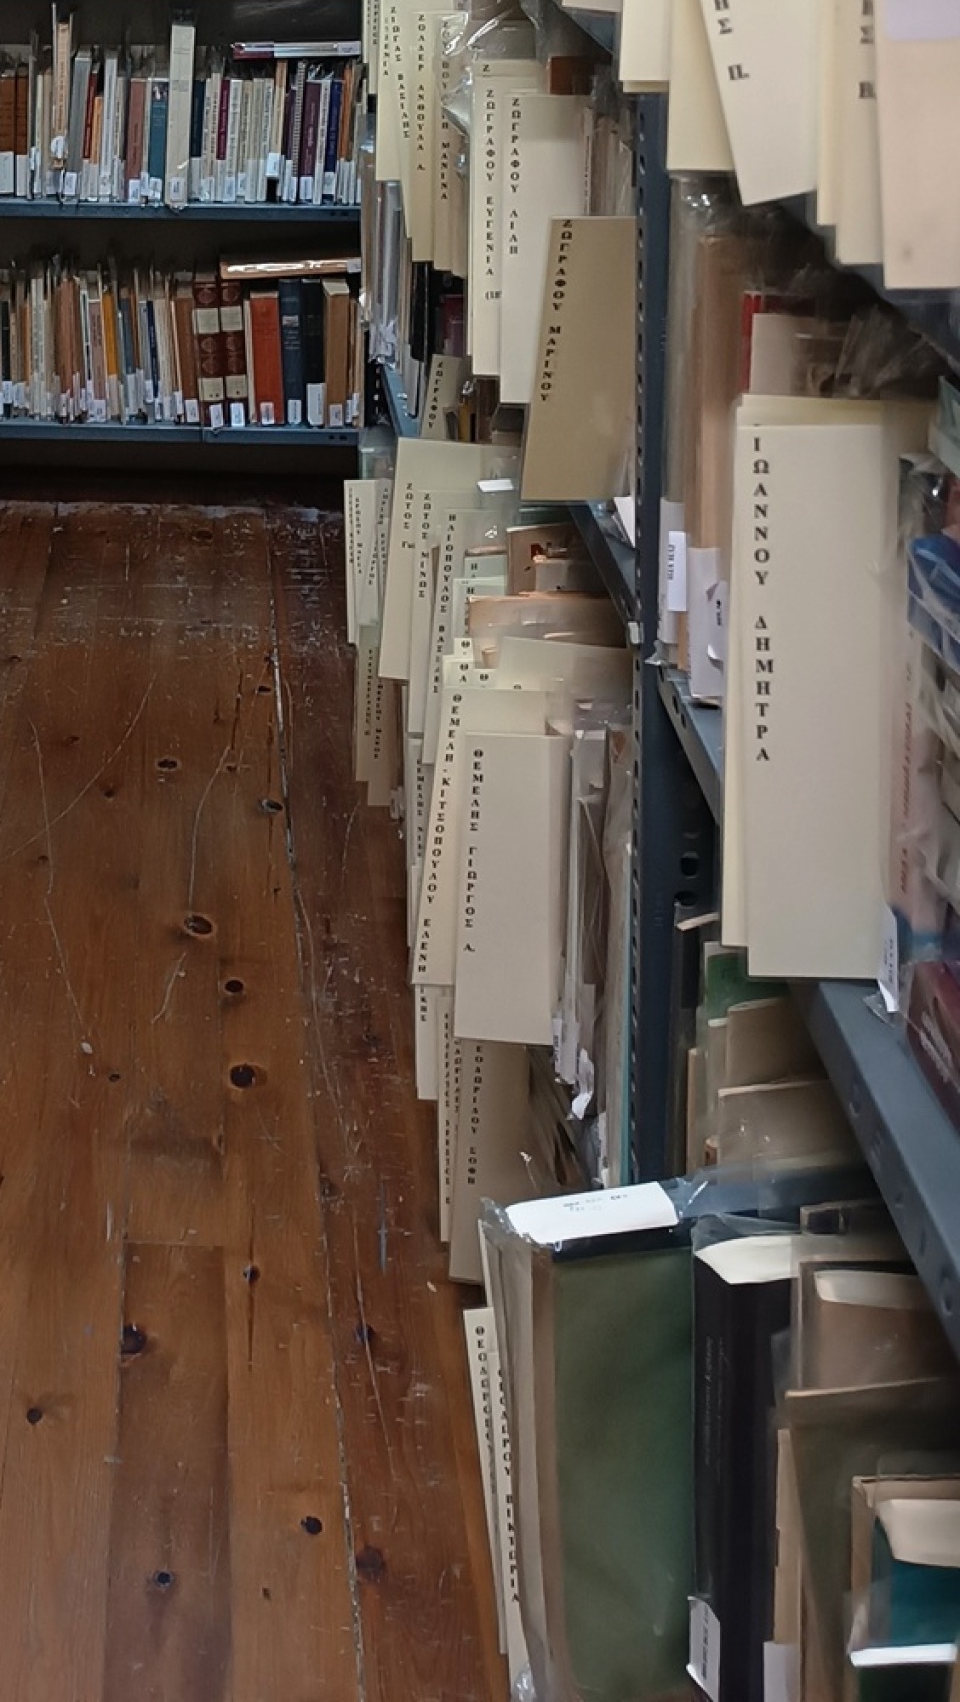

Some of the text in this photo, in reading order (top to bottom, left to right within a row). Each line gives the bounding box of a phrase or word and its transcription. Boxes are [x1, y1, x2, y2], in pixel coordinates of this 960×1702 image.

[510, 98, 521, 194] ΖΩΓΡΑΦΟΥ
[753, 437, 775, 761] ΙΩΑΝΝΟΥ ΔΗΜΗΤΡΑ
[469, 748, 484, 831] ΘΕΜΕΛΗΣ
[464, 847, 478, 928] ΓΙΩΡΓΟΣ
